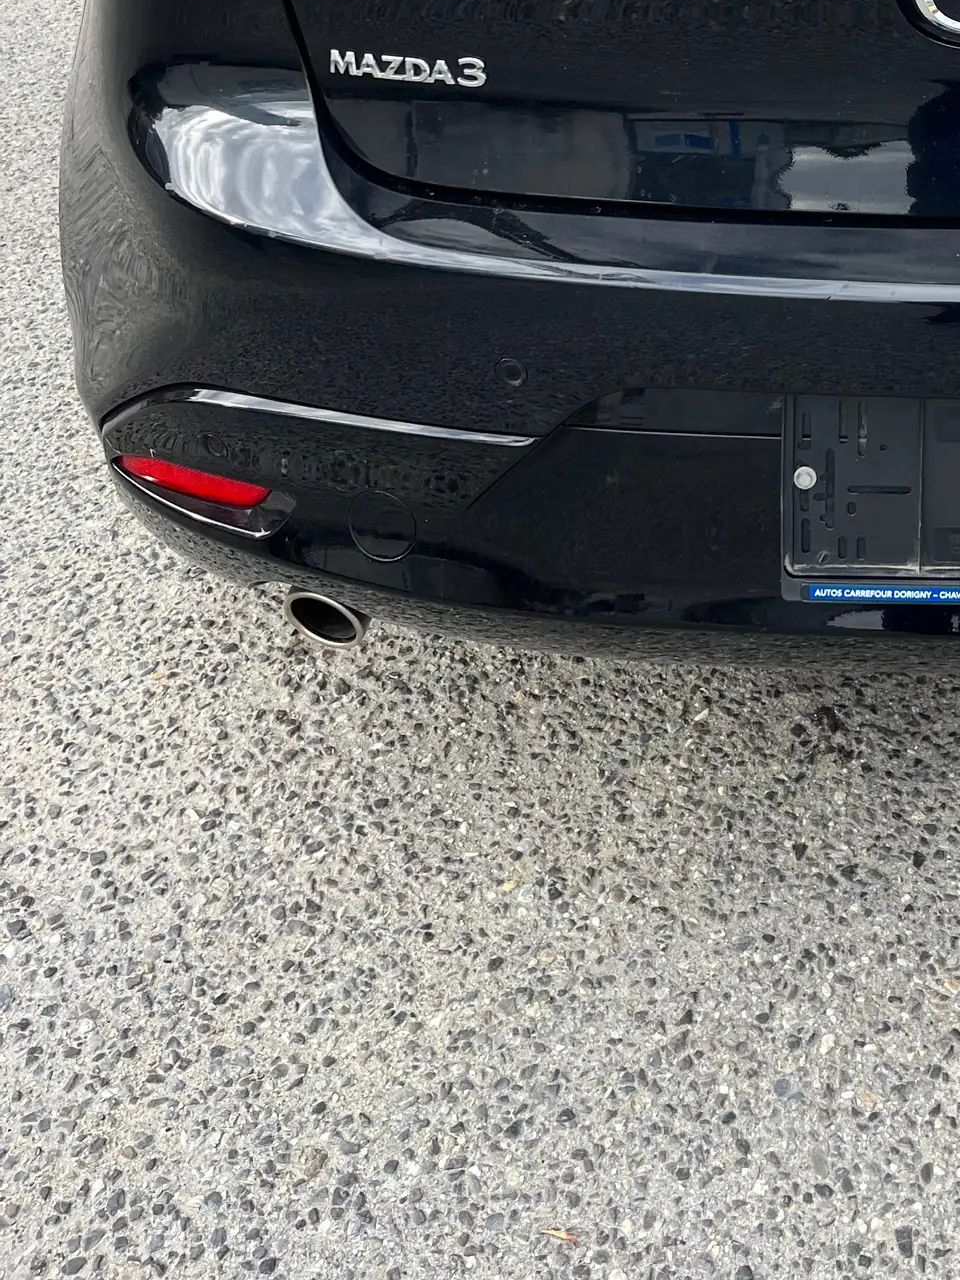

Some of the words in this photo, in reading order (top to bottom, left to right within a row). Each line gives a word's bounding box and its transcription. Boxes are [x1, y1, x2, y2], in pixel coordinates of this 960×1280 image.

[814, 588, 843, 598] AUTOS
[843, 589, 893, 599] CARREFOUR
[893, 590, 932, 600] DORIGNY
